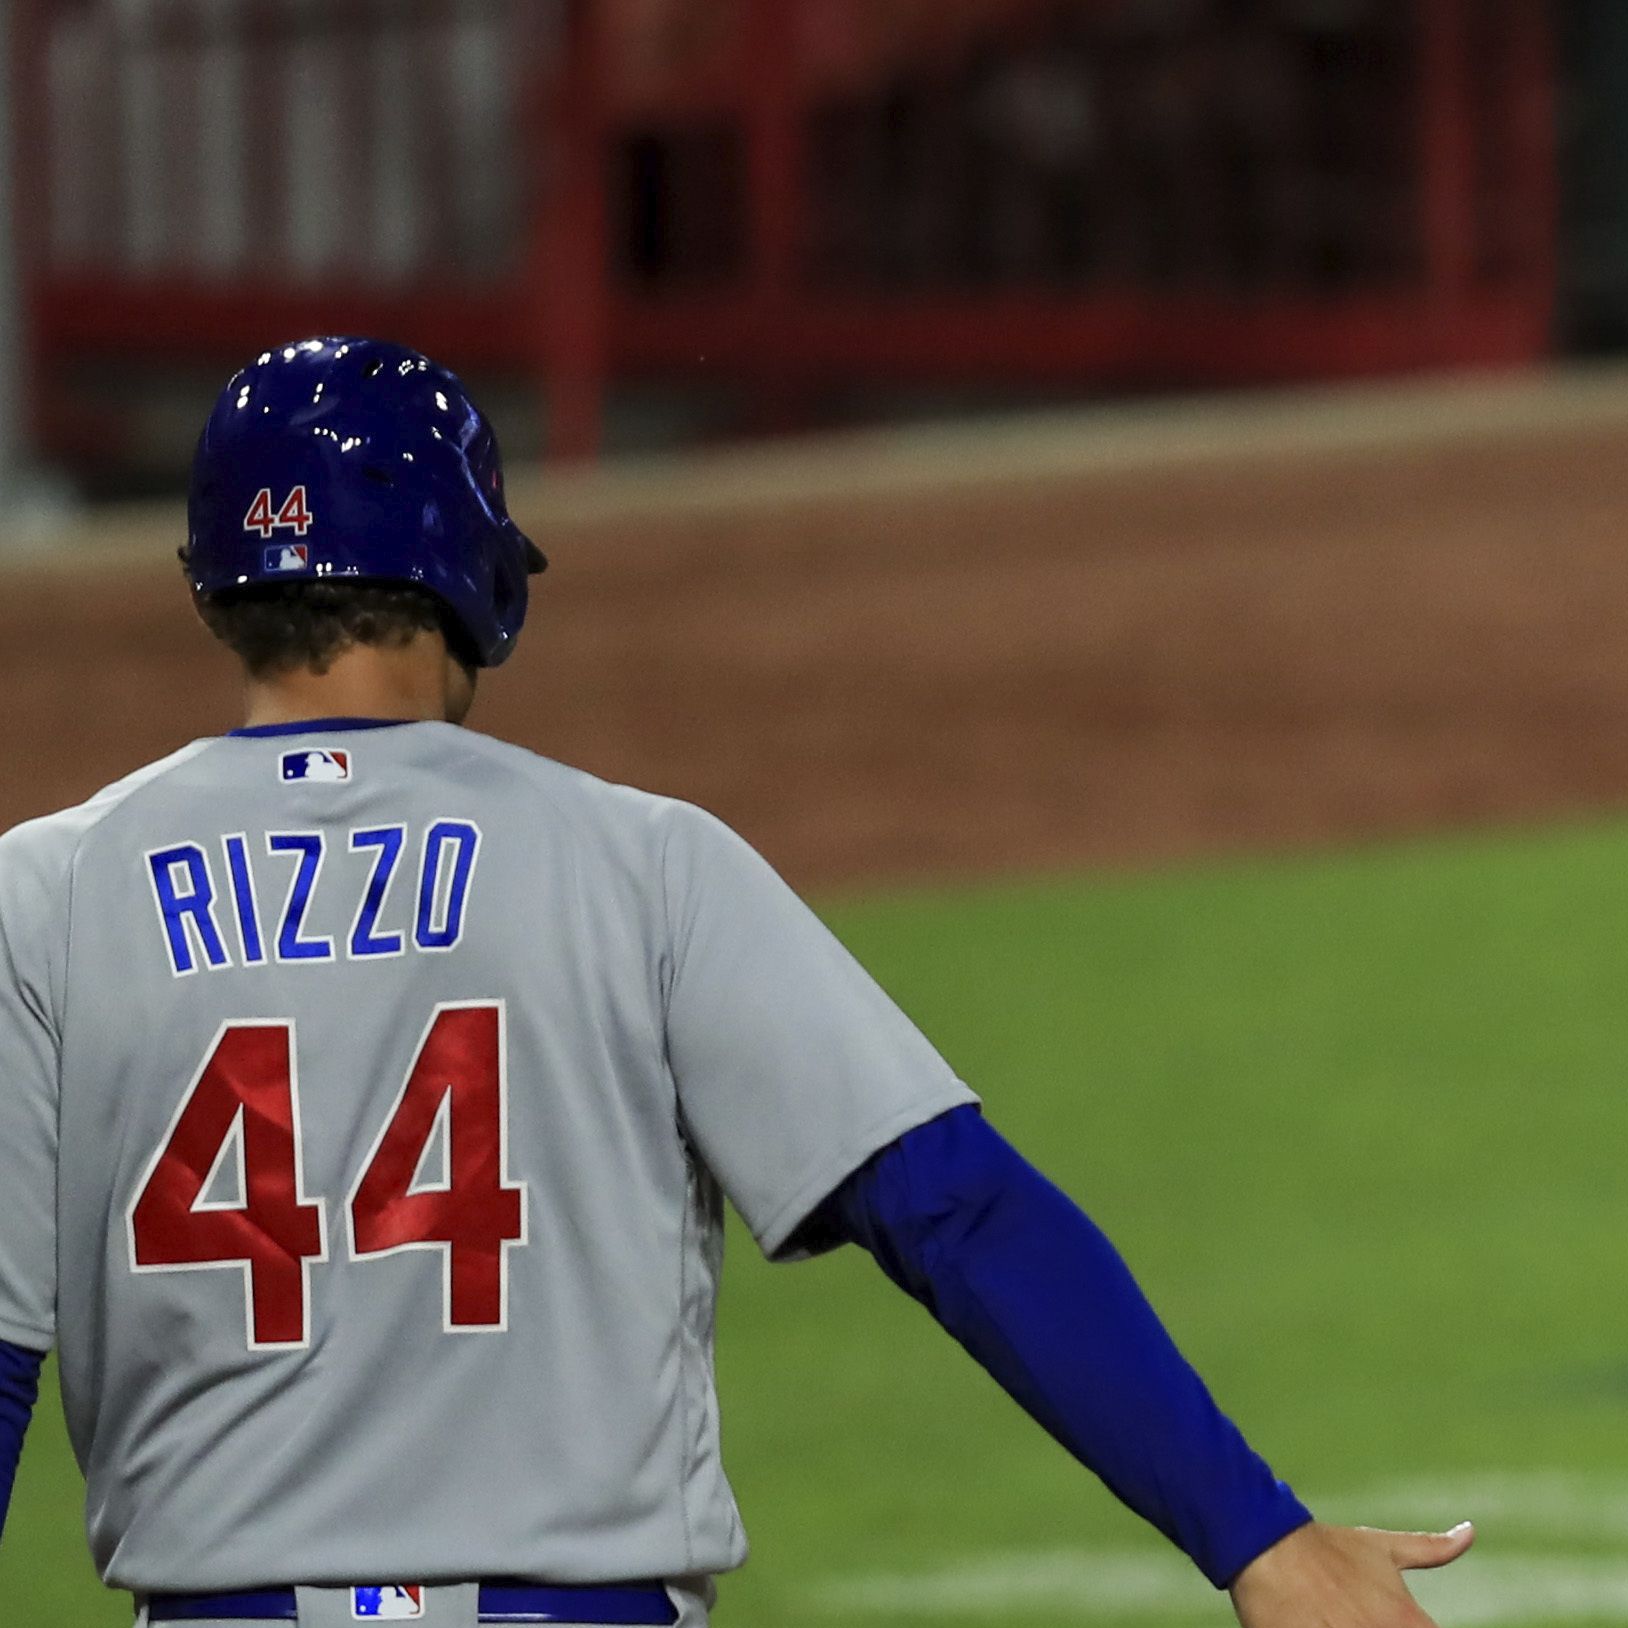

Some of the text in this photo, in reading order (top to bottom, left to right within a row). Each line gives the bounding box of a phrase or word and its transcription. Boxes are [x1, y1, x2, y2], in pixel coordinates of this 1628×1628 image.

[243, 485, 313, 538] 44
[144, 817, 482, 978] RIZZO
[125, 998, 529, 1351] 44
